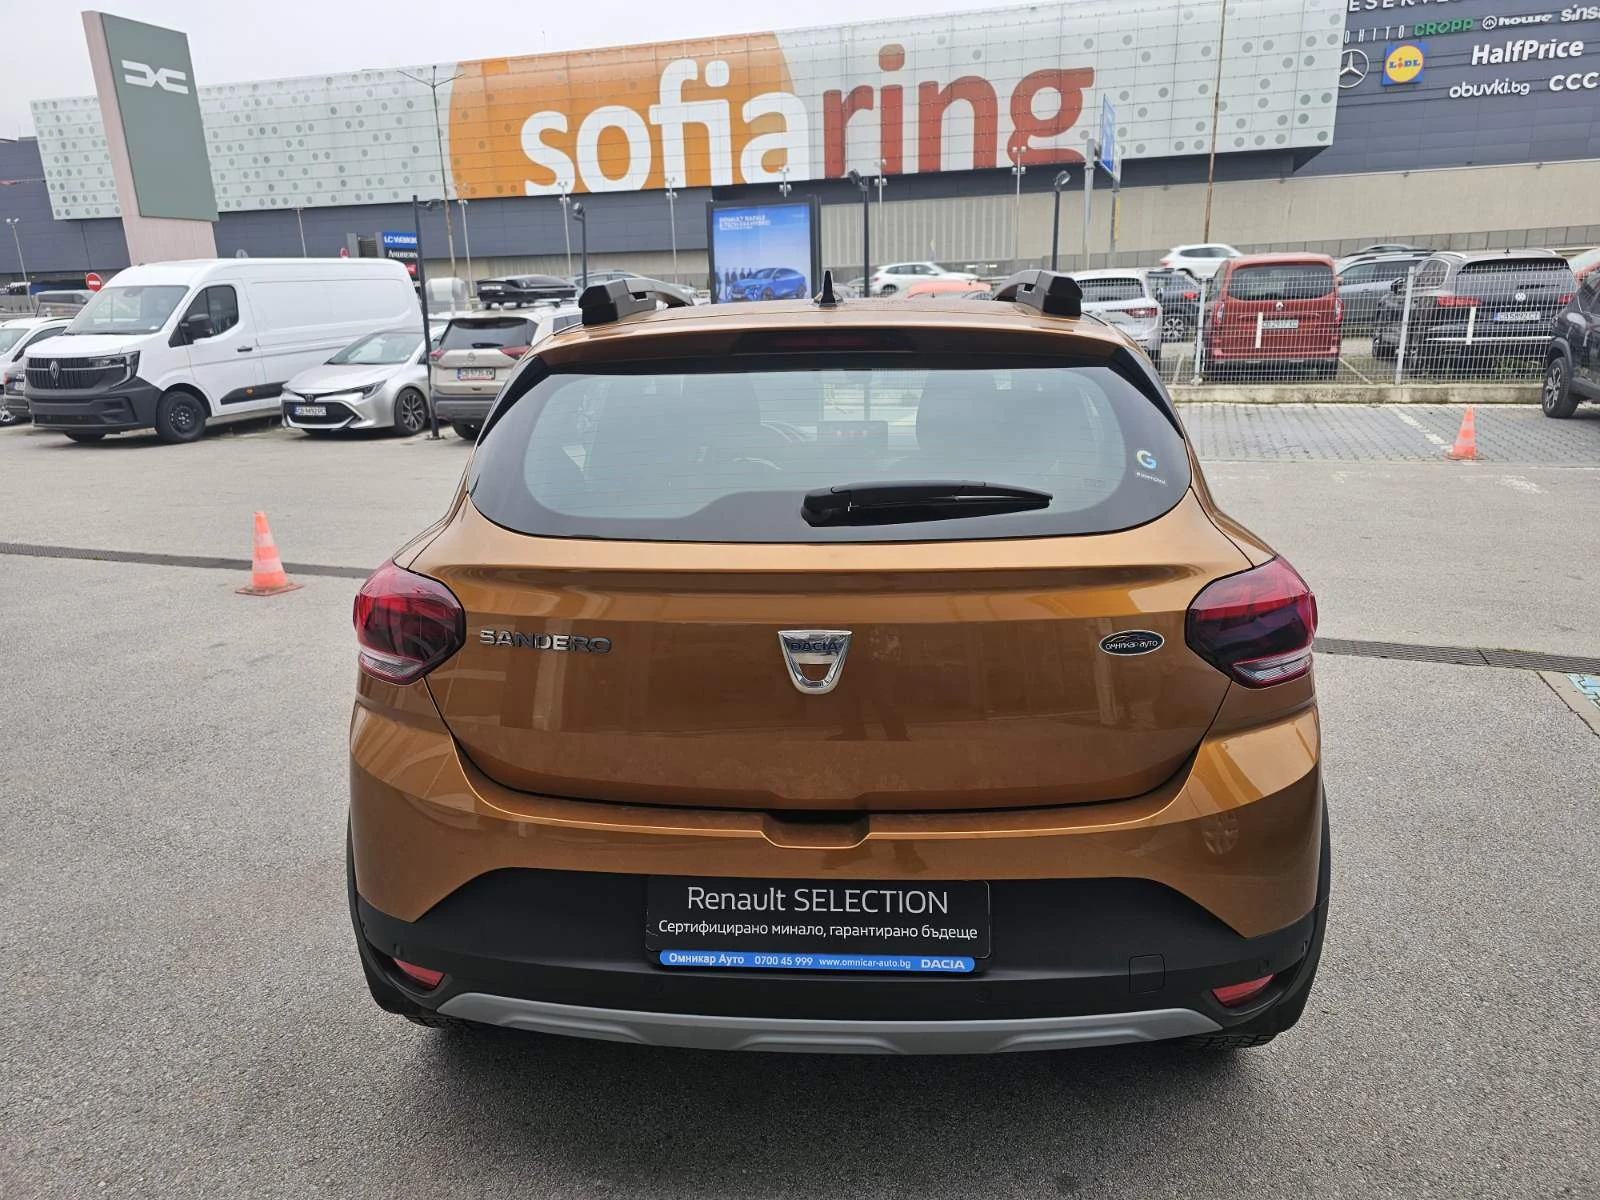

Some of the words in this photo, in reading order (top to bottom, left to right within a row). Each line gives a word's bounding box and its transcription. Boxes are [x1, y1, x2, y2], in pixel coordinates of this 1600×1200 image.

[1498, 13, 1553, 26] house
[1560, 3, 1600, 22] sins
[1414, 18, 1473, 36] CROPP
[1471, 38, 1584, 66] HalfPrice
[1449, 77, 1530, 98] obuvki.bg
[1549, 71, 1600, 92] CCC
[479, 629, 612, 655] SANDERO
[791, 641, 838, 652] DACIA
[687, 886, 787, 911] Renault
[794, 888, 948, 914] SELECTION
[658, 919, 768, 937] Сертифицирано
[771, 924, 827, 938] минало,
[830, 924, 918, 940] гарантирано
[921, 924, 978, 941] бъдеще
[669, 953, 717, 966] Омникар
[718, 954, 745, 967] Ауто
[755, 956, 778, 966] 0700
[781, 957, 793, 966] 45
[794, 957, 813, 967] 999
[819, 957, 911, 970] www.omnicar-auto.bg
[921, 959, 965, 969] DACIA
